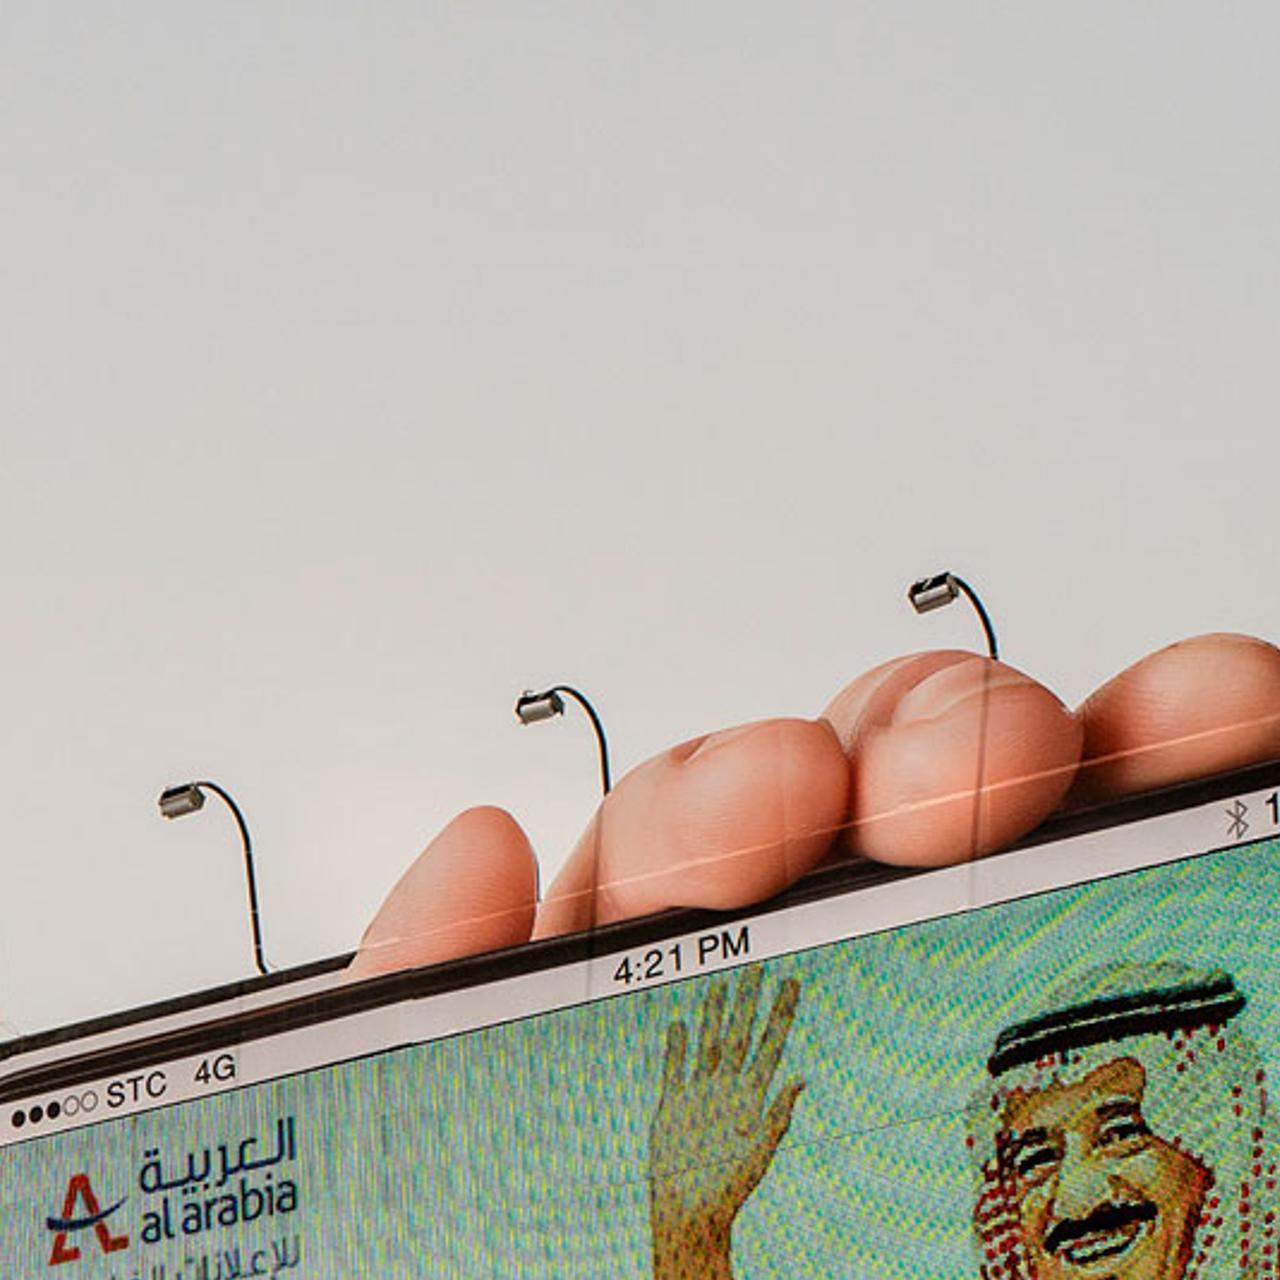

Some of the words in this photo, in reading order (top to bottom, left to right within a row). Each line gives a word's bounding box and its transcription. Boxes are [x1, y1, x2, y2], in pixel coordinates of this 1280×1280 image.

[613, 943, 682, 984] 4:21
[698, 926, 750, 965] PM
[106, 1070, 167, 1109] STC
[194, 1053, 236, 1084] 4G
[140, 1116, 297, 1195] العربية
